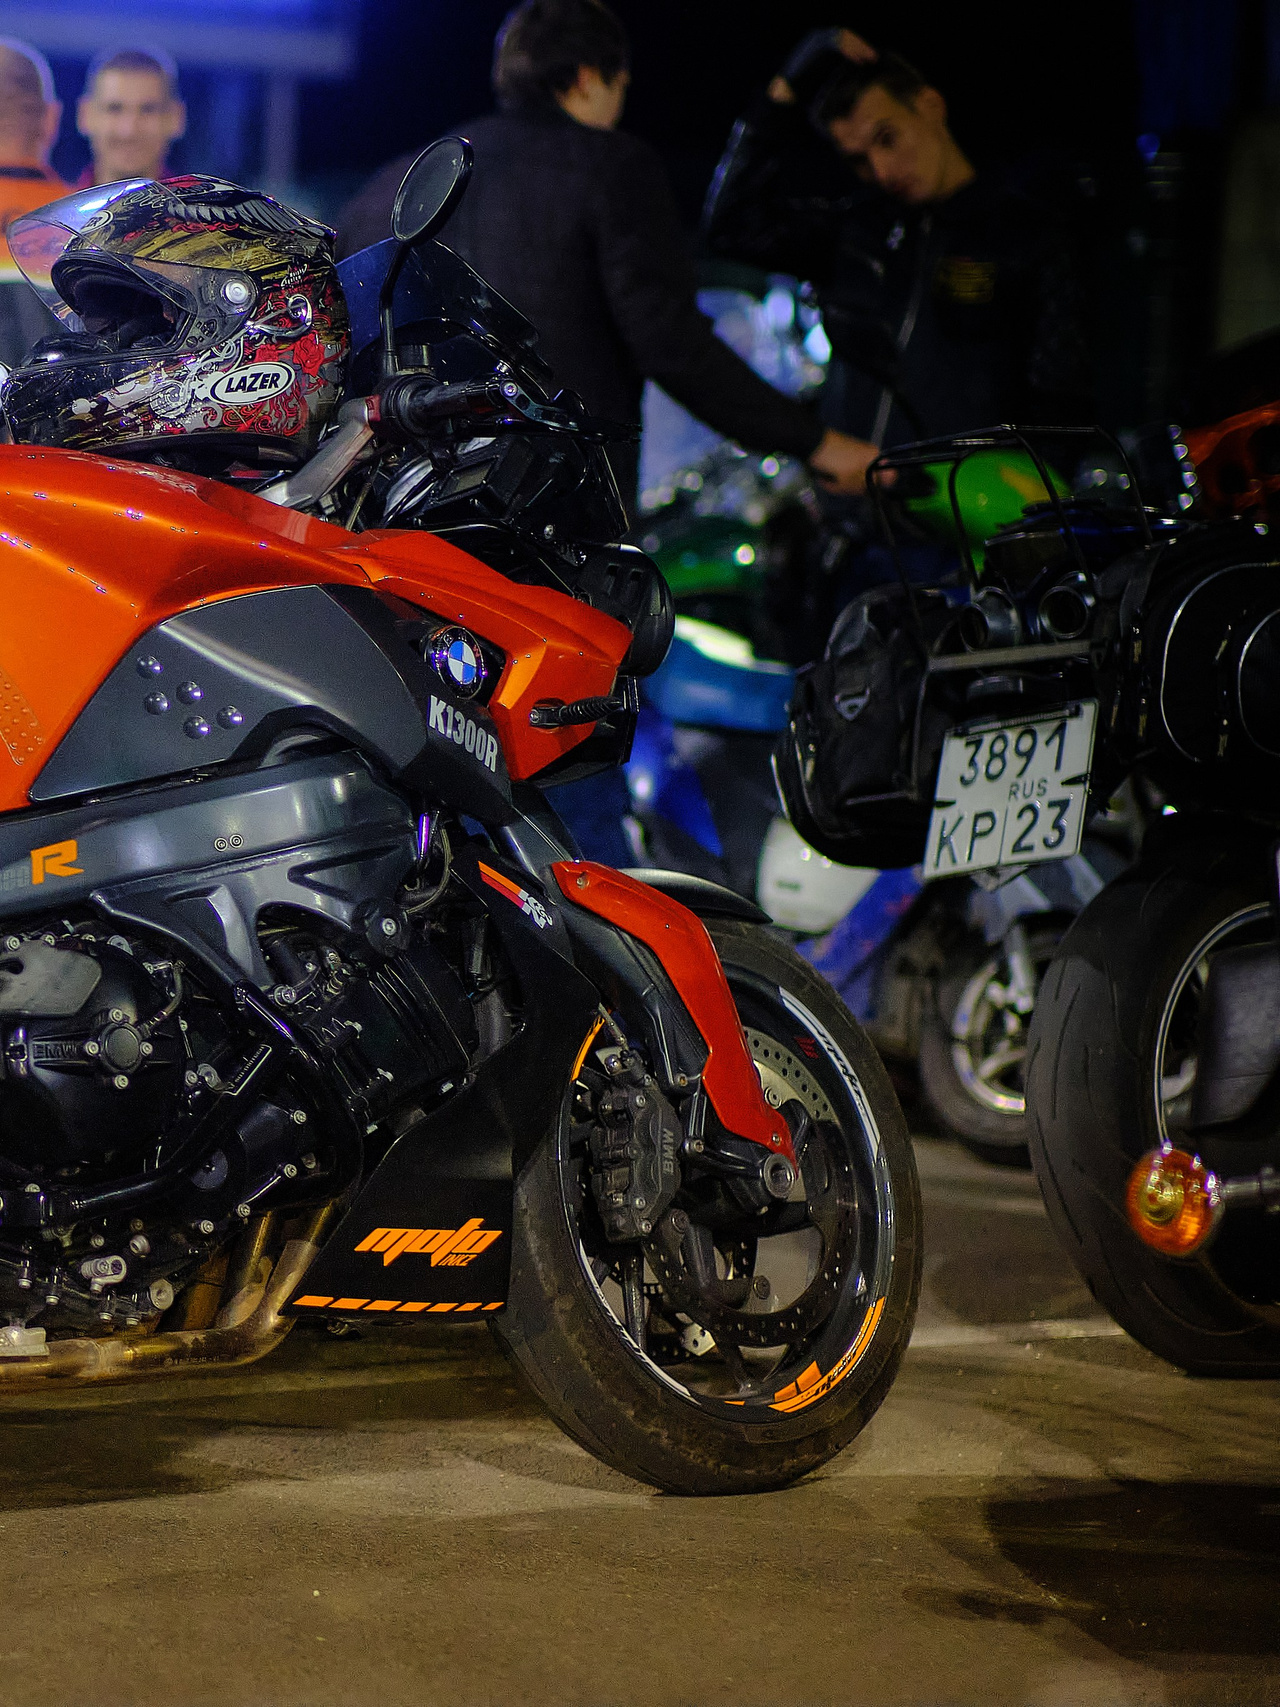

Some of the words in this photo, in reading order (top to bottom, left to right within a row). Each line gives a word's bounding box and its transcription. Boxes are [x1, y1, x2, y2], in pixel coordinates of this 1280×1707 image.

[225, 372, 281, 393] LAZER
[428, 694, 499, 773] K1300R
[959, 716, 1068, 787] 3891
[1007, 778, 1049, 802] RUS
[1010, 798, 1071, 855] 23
[661, 1127, 675, 1176] BMW
